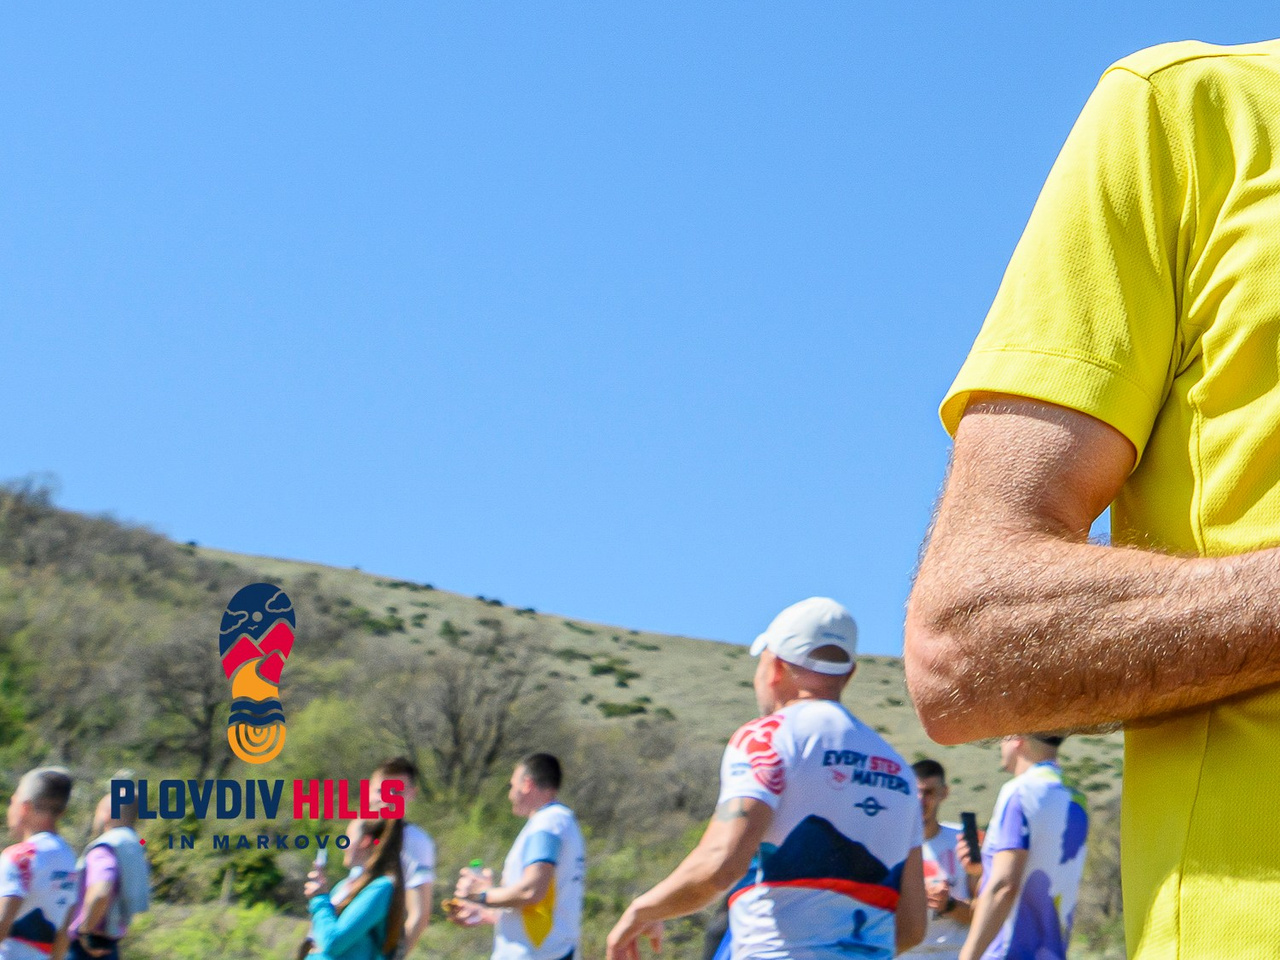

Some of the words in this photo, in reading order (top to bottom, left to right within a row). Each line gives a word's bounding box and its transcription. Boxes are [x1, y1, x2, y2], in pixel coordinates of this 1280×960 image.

[823, 750, 868, 769] EVERY
[869, 756, 902, 775] STEP
[851, 770, 911, 796] MATTERS
